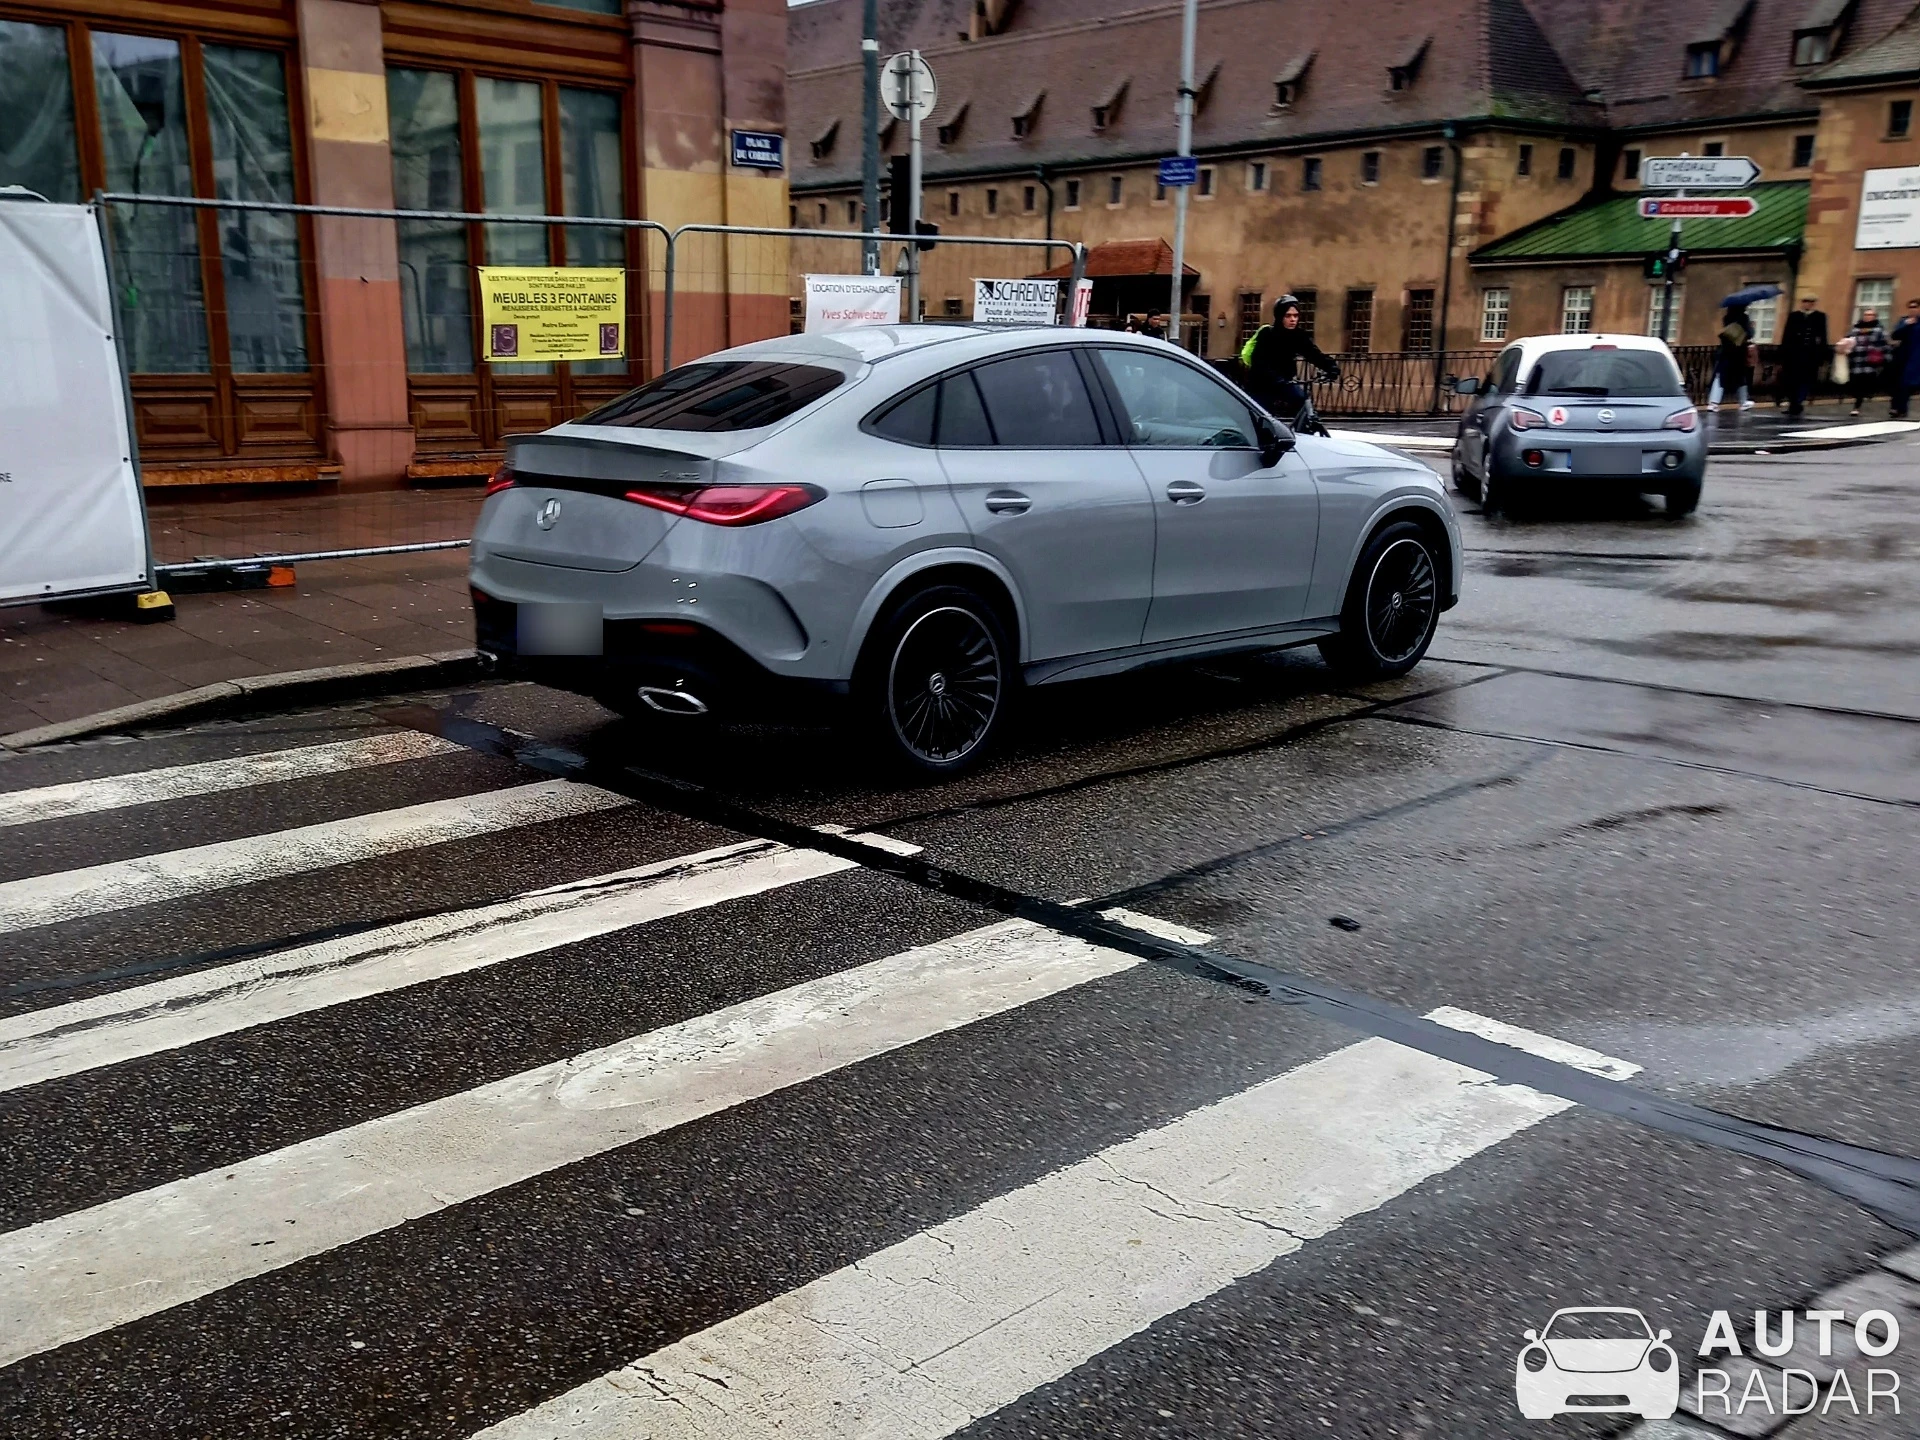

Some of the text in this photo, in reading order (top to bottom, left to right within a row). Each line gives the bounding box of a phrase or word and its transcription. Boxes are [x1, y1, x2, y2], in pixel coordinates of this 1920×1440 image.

[736, 149, 747, 159] DU
[1661, 203, 1718, 214] Gutenberg
[812, 284, 844, 292] LOCATION
[994, 282, 1056, 302] SCHREINER
[493, 292, 617, 304] MEUBLES 3 FONTAINES
[822, 309, 888, 320] Yves Schweitzer
[1553, 410, 1563, 422] A
